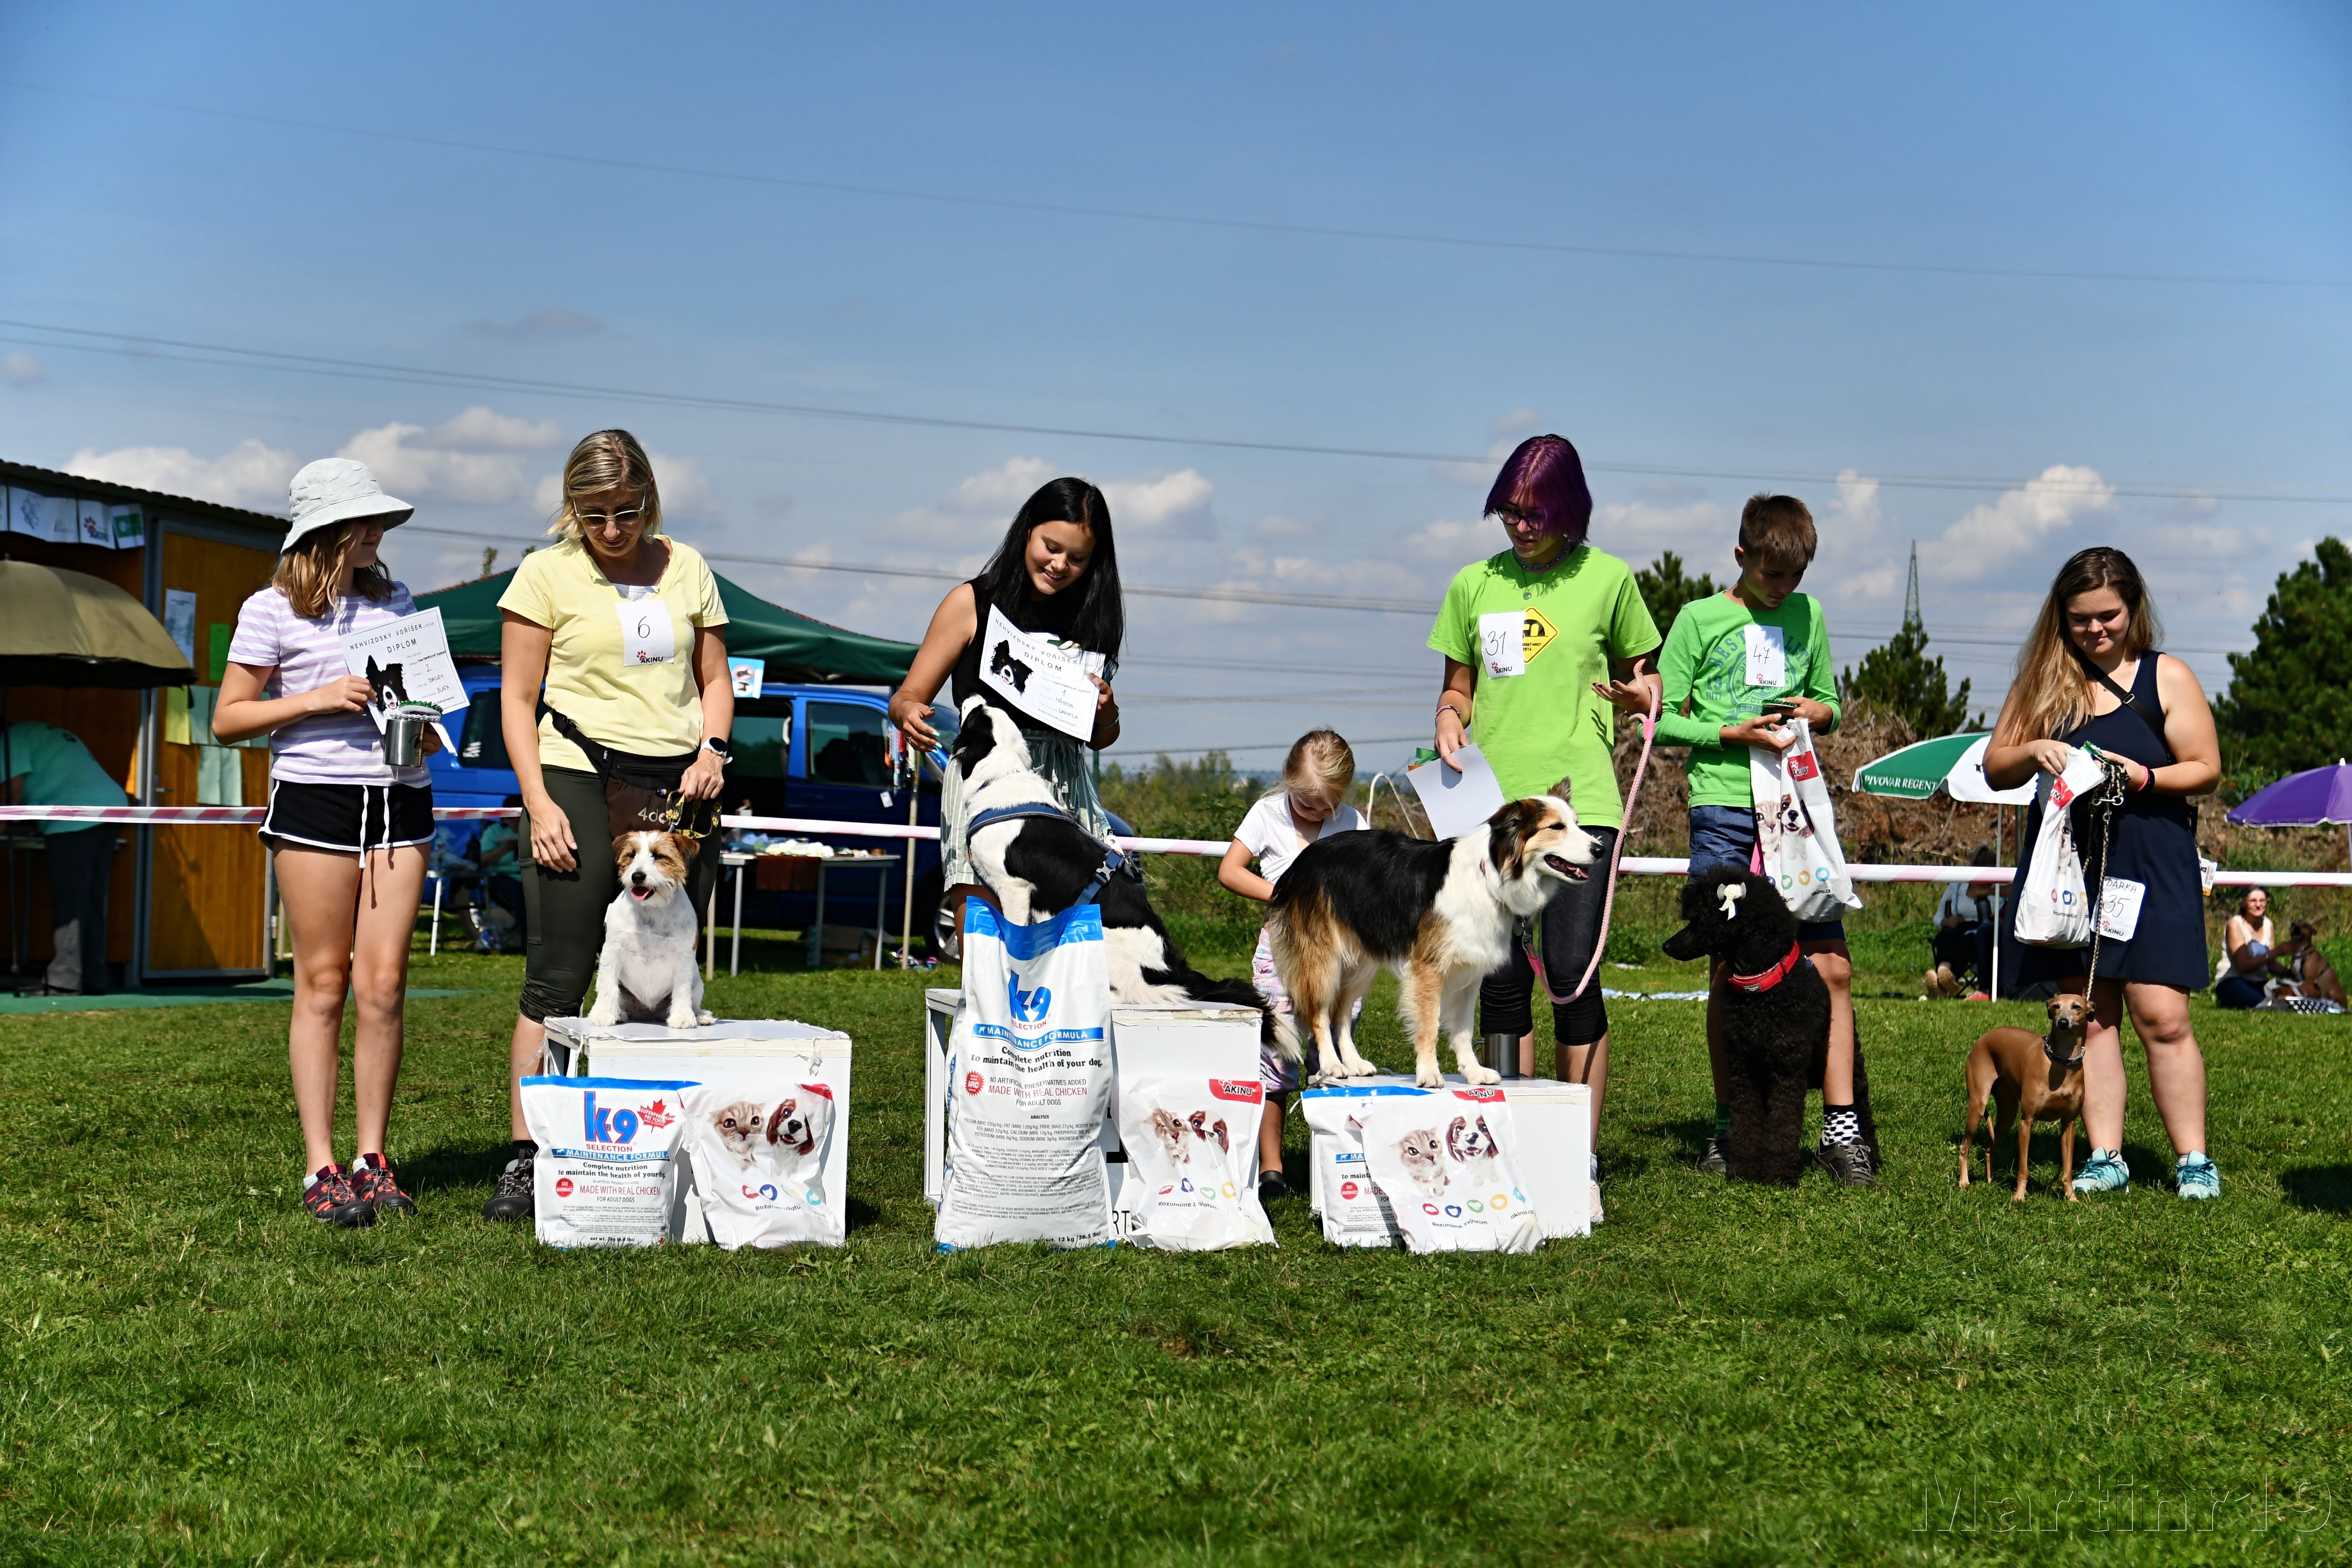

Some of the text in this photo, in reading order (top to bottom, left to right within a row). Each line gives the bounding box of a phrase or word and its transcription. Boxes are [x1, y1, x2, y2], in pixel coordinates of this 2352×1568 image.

[638, 616, 650, 638] 6
[350, 632, 392, 650] NEHVIZDSKÝ
[395, 623, 423, 636] VOŘÍŠEK
[996, 618, 1078, 664] NEHVIZDSKÝ VOŘÍŠEK
[387, 638, 417, 653] DIPLOM
[1485, 631, 1506, 656] 31
[1753, 645, 1769, 664] 47
[426, 664, 433, 672] 2
[1025, 652, 1062, 671] DIPLOM
[428, 674, 444, 683] BAILEY
[1707, 675, 1723, 690] 19
[436, 685, 450, 693] ZLATA
[1706, 692, 1722, 700] FIFTY
[1059, 708, 1078, 719] DANIELA
[1865, 774, 1938, 791] PIVOVAR REGENT
[2106, 879, 2137, 893] DARKA
[2103, 895, 2131, 917] 35
[2104, 928, 2124, 936] AKINU
[987, 1027, 1088, 1048] MAINTENANCE FORMULA
[1002, 1046, 1071, 1064] Complete nutrition
[983, 1056, 1014, 1067] maintain
[1015, 1062, 1025, 1073] the
[1028, 1060, 1055, 1073] health
[1057, 1059, 1065, 1067] of
[1066, 1061, 1086, 1069] your
[1089, 1058, 1103, 1068] dog.
[968, 1080, 979, 1089] NRC
[998, 1077, 1023, 1089] ARTIFICIAL
[1025, 1079, 1067, 1089] PRESERVATIVES
[988, 1085, 1087, 1098] MADE WITH REAL CHICKEN
[1225, 1086, 1253, 1095] AKINU
[586, 1143, 632, 1152] SELECTION
[566, 1149, 627, 1161] MAINTENANCE
[583, 1162, 613, 1171] Complete
[580, 1185, 599, 1194] MADE
[600, 1186, 617, 1195] WITH
[636, 1187, 660, 1195] CHICKEN
[1510, 1210, 1534, 1219] akinu.cz
